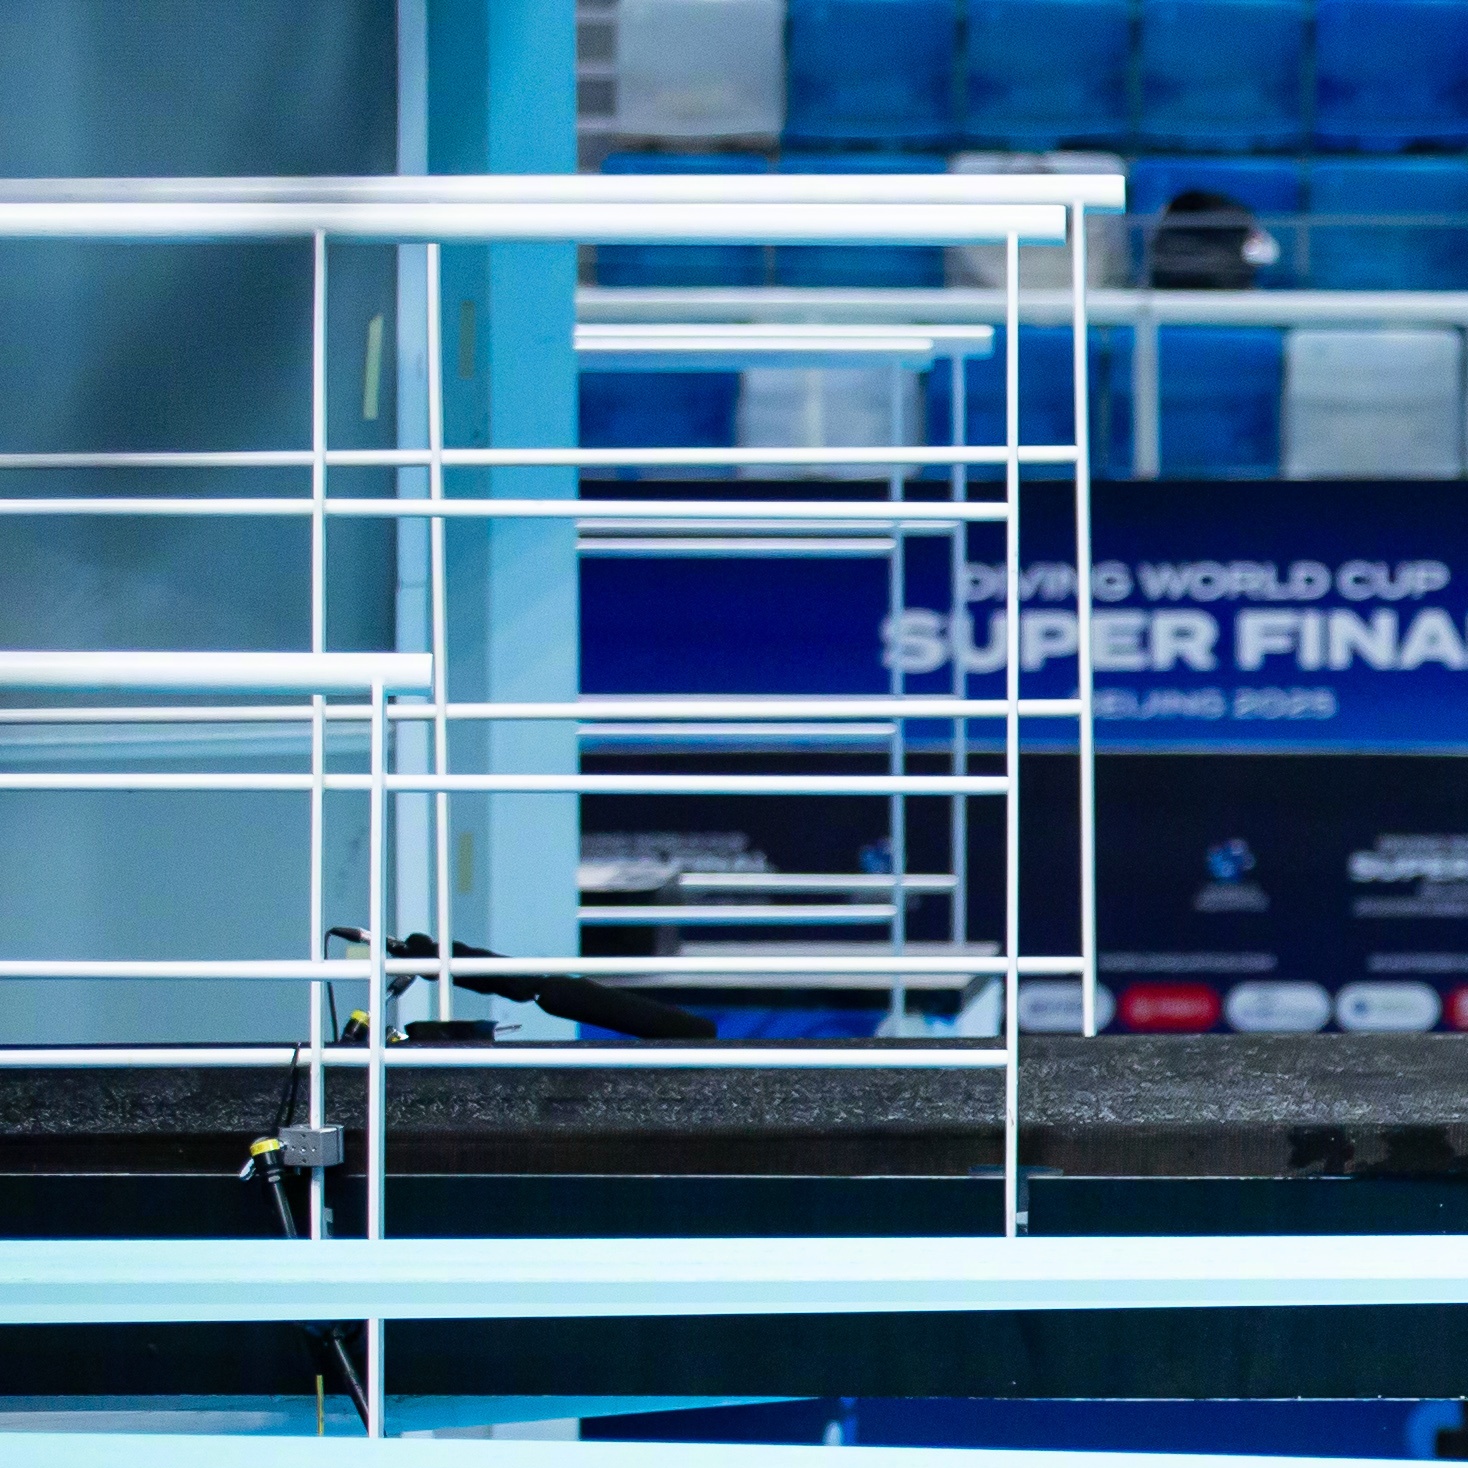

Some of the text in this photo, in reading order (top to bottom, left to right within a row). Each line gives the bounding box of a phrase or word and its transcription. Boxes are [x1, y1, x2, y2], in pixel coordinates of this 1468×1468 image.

[1138, 561, 1333, 602] WORLD
[1337, 561, 1450, 602] CUP
[882, 607, 1219, 674] SUPER
